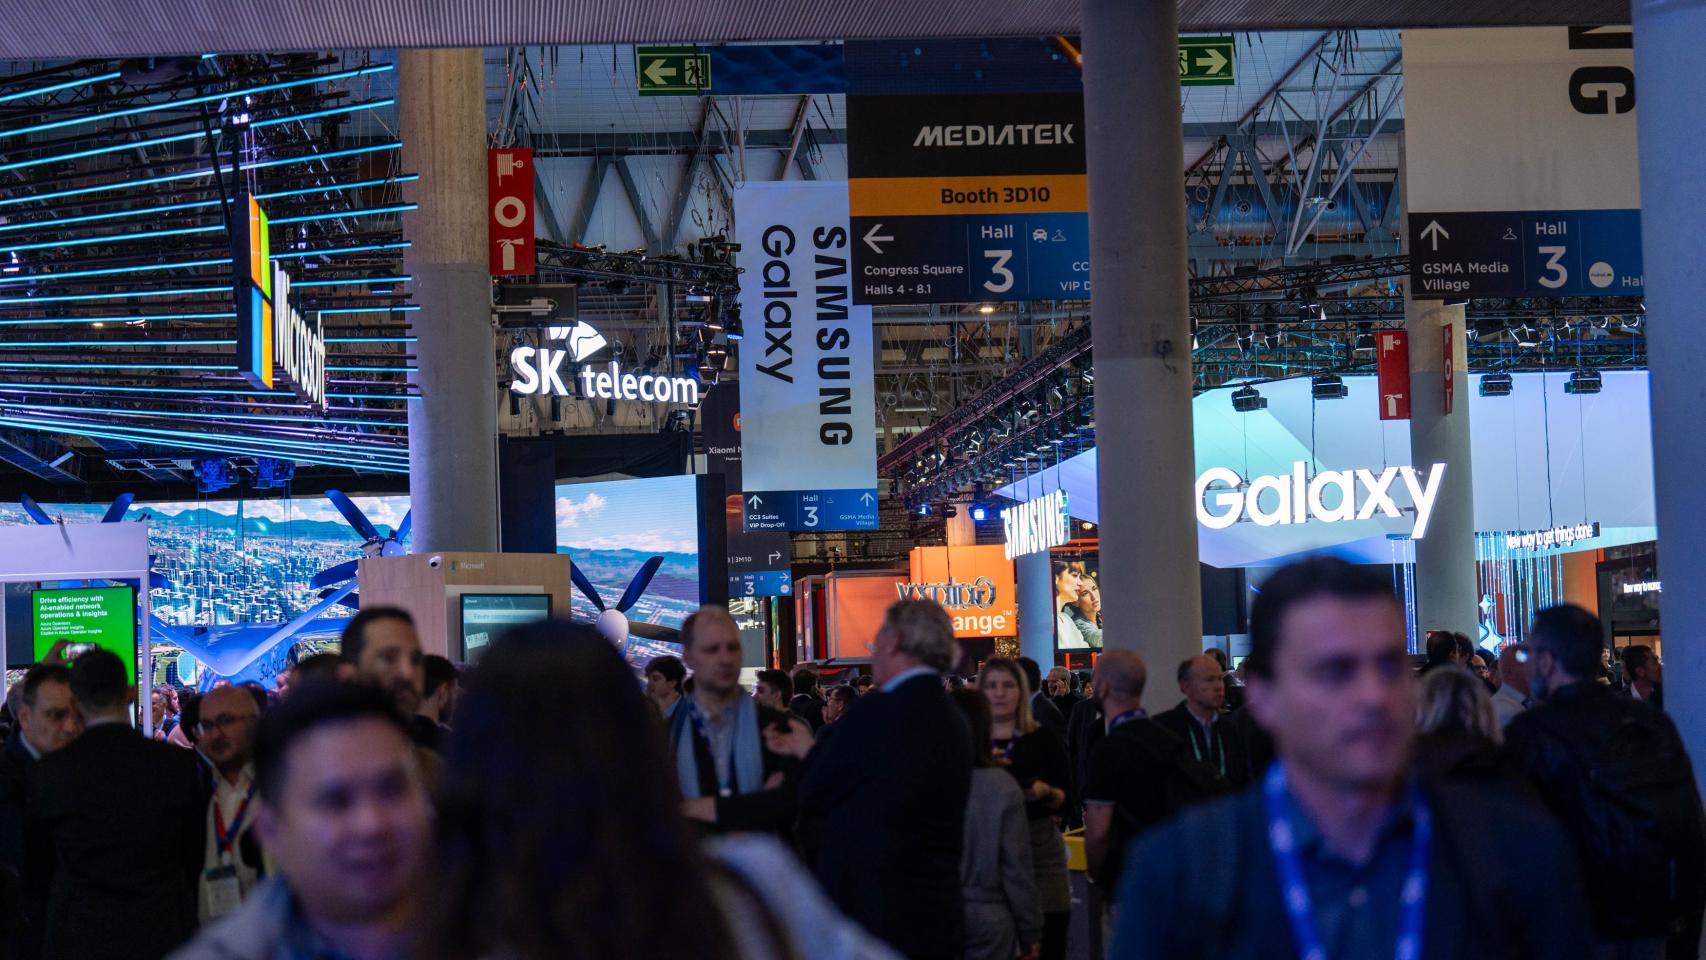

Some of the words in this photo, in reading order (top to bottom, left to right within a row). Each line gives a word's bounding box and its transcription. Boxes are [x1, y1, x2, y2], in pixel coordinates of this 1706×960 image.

[913, 124, 1074, 147] MEDIATEK
[941, 187, 998, 204] Booth
[1003, 187, 1050, 203] 3D10
[981, 224, 1014, 239] Hall
[1535, 221, 1567, 236] Hall
[864, 265, 919, 277] Congress
[922, 264, 964, 277] Square
[983, 249, 1015, 293] 3
[1072, 261, 1090, 272] CC
[1422, 263, 1464, 275] GSMA
[1468, 261, 1510, 273] Media
[1537, 246, 1568, 289] 3
[865, 284, 893, 296] Halls
[896, 284, 905, 295] 4
[916, 283, 931, 295] 8.1
[1060, 280, 1081, 291] VIP
[1423, 279, 1470, 292] Village
[756, 224, 796, 384] Galaxy
[273, 259, 326, 408] Microsoft
[812, 226, 853, 446] SAMSUNG
[511, 346, 569, 396] SK
[582, 361, 697, 404] telecom
[709, 446, 736, 454] Xiaomi
[1195, 461, 1447, 539] Galaxy
[804, 506, 819, 527] 3
[1004, 489, 1067, 560] SAMSUNG
[1506, 534, 1520, 549] New
[1521, 533, 1535, 551] way
[1536, 530, 1543, 545] to
[1543, 528, 1554, 549] get
[1554, 525, 1574, 546] things
[1575, 523, 1593, 540] done
[745, 582, 755, 595] 3
[58, 595, 89, 604] efficiency
[40, 611, 74, 620] operations
[82, 610, 108, 618] insights
[952, 615, 1006, 635] ange
